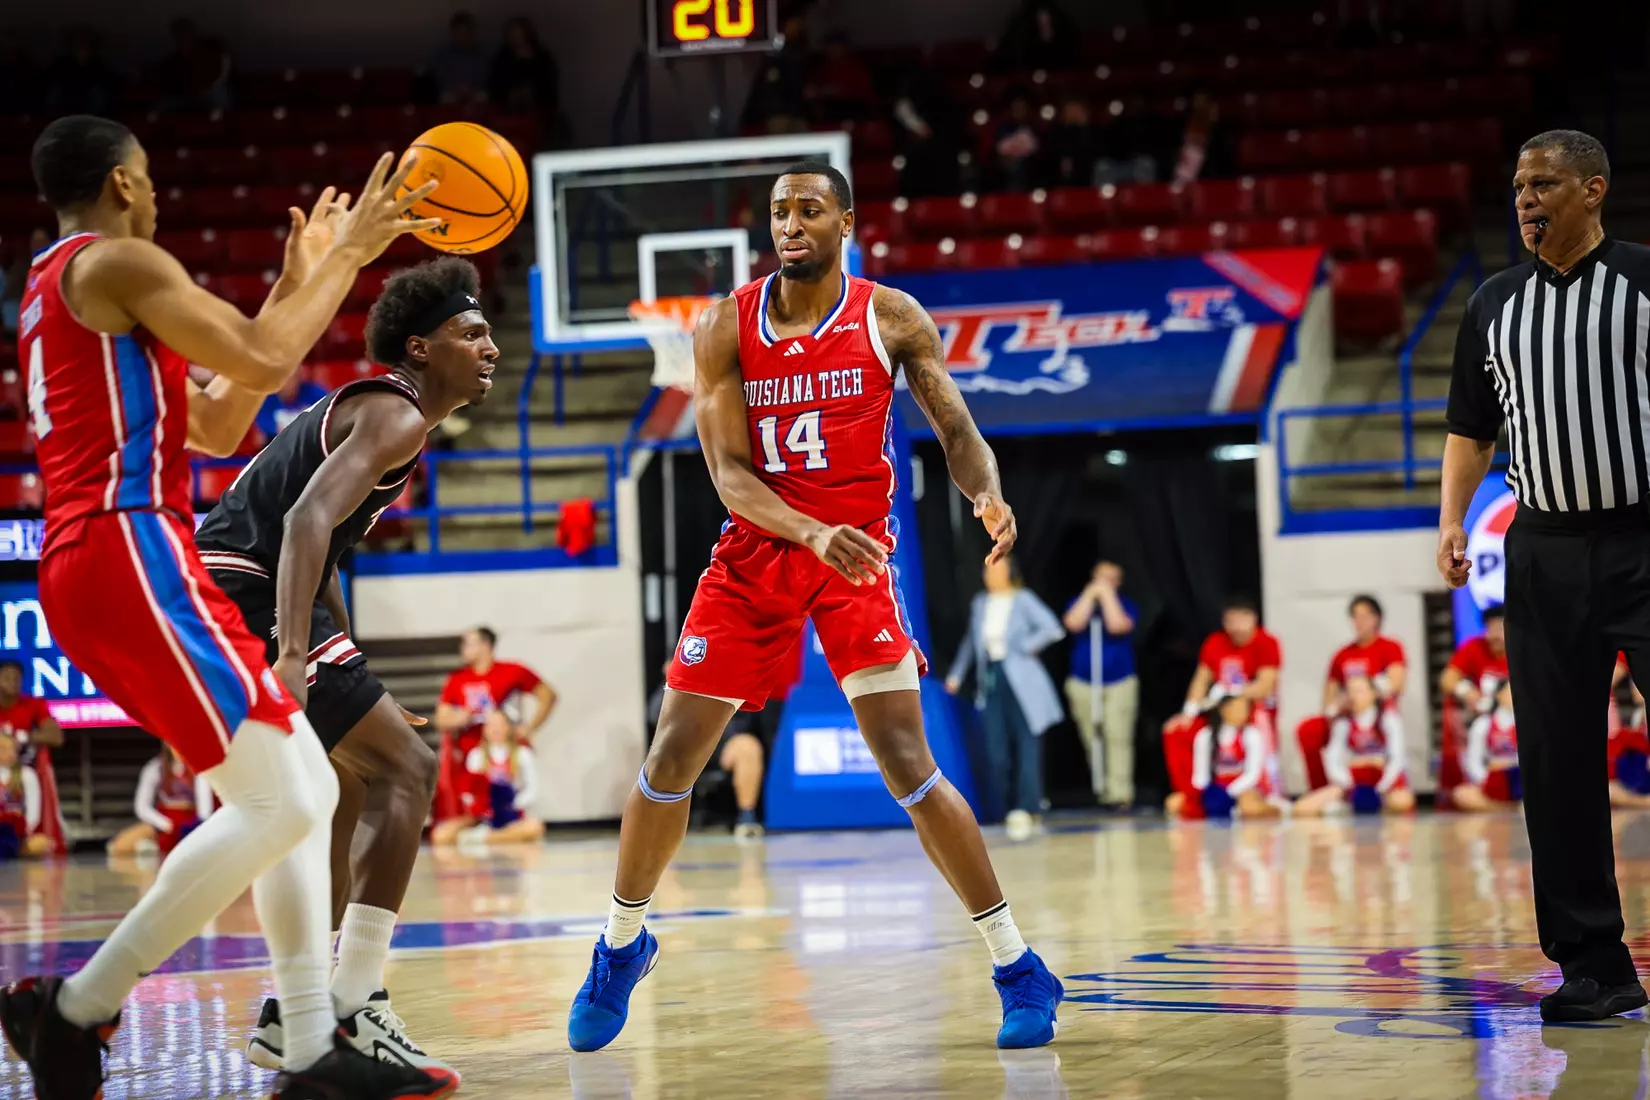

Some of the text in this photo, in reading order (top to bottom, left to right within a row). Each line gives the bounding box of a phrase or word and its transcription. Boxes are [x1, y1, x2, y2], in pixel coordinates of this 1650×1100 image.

[673, 0, 755, 41] 20
[743, 367, 863, 407] OUISIANA TECH
[758, 410, 828, 473] 14
